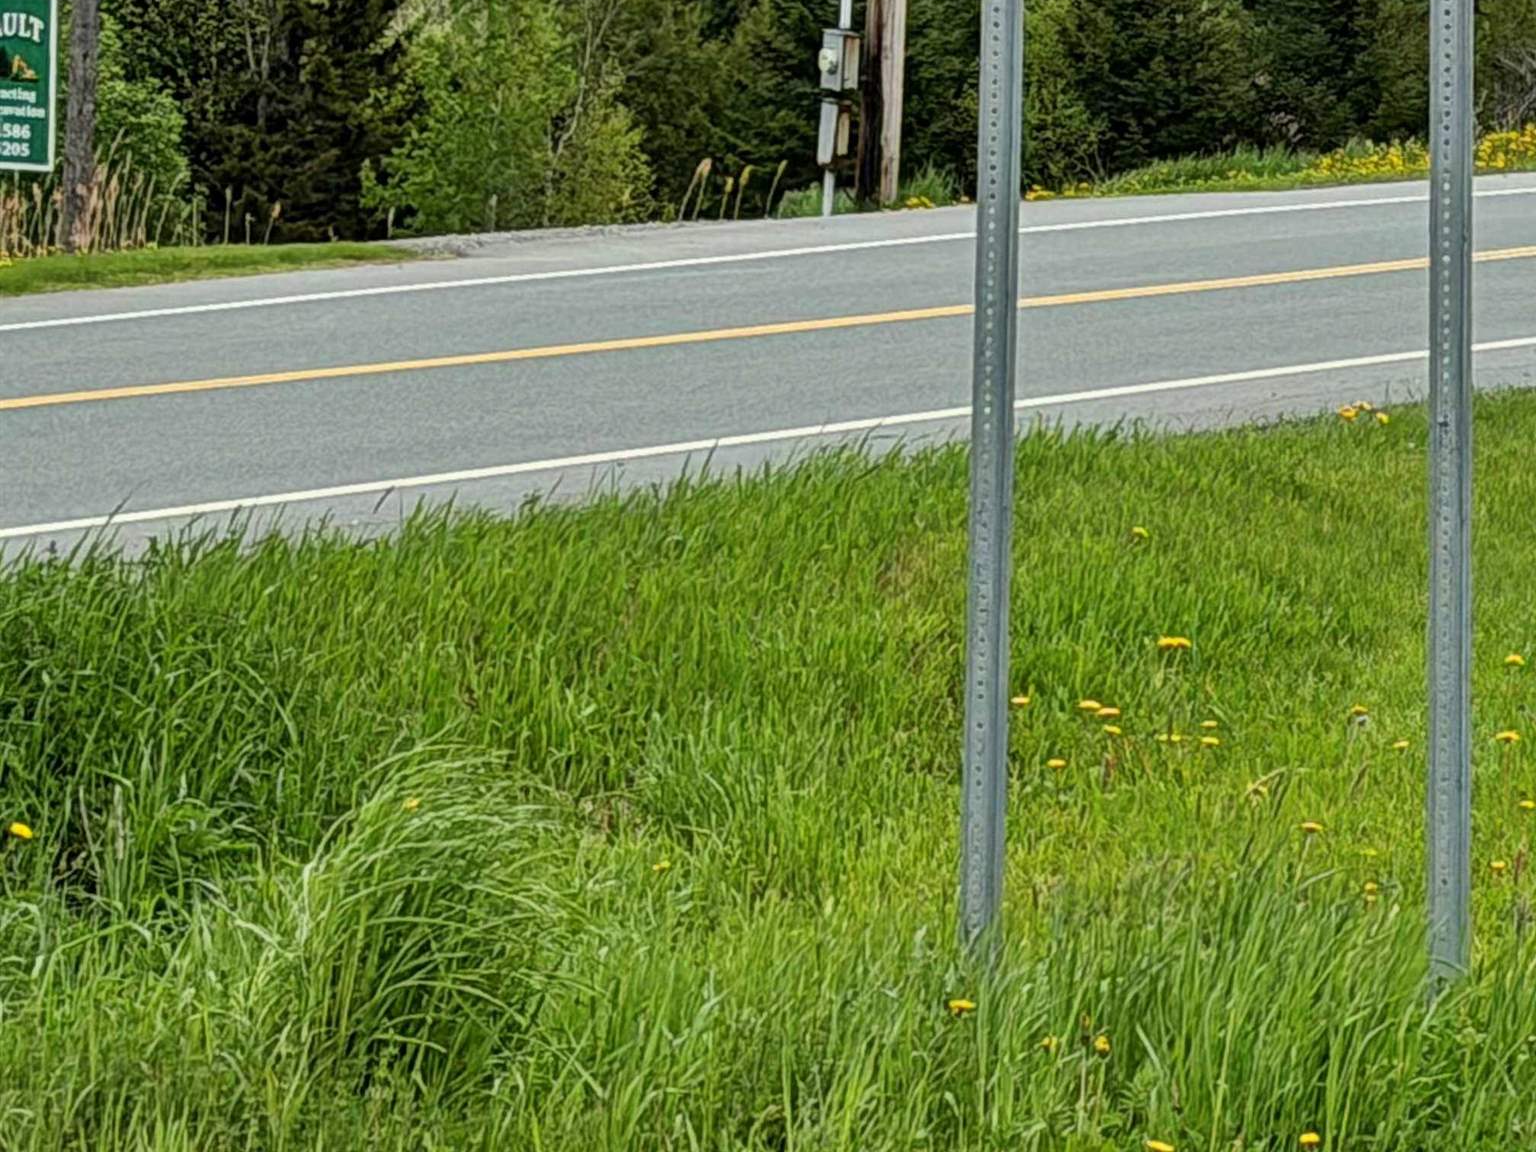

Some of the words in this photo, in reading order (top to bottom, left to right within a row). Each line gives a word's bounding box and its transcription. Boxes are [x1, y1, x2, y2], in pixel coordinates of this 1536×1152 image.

[0, 12, 45, 43] ULT
[0, 122, 31, 139] 586
[0, 141, 31, 157] 205
